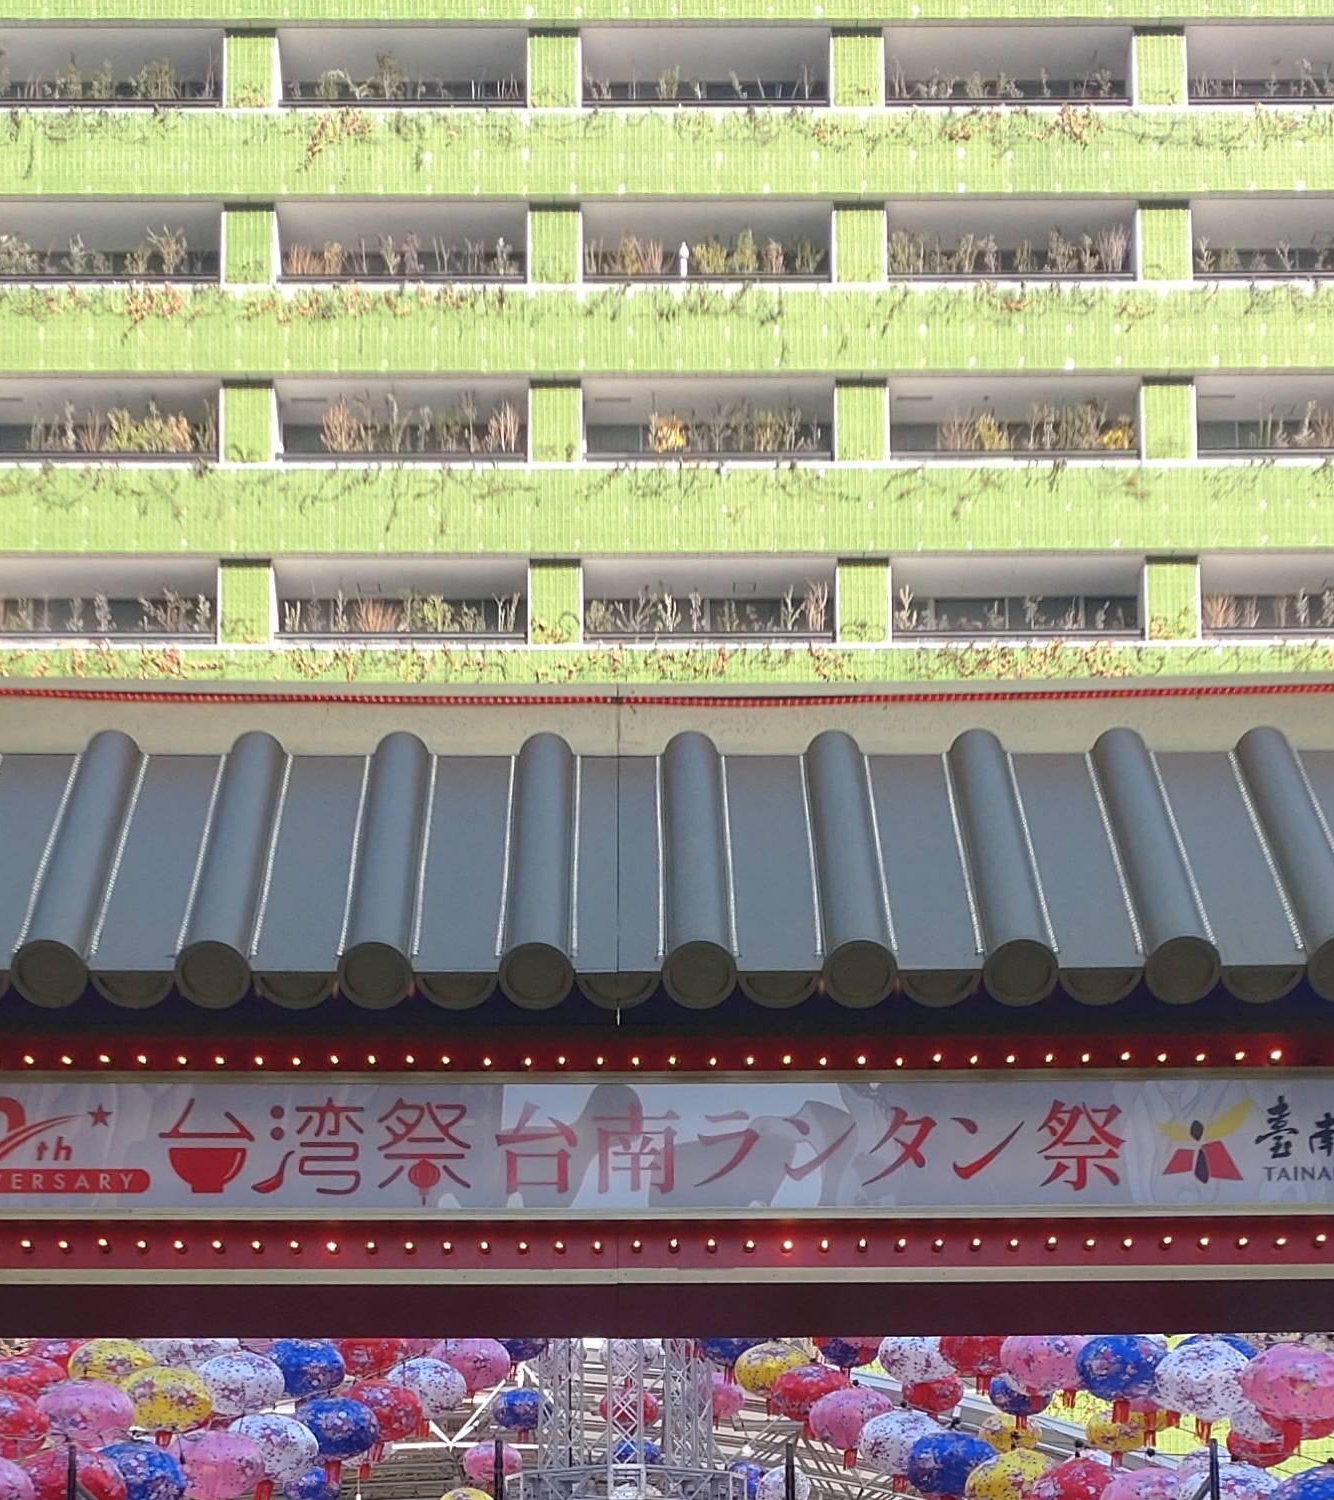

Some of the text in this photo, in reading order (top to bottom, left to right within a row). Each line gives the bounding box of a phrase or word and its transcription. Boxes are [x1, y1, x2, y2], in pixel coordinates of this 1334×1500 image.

[495, 1098, 1126, 1194] 台南ランタン祭
